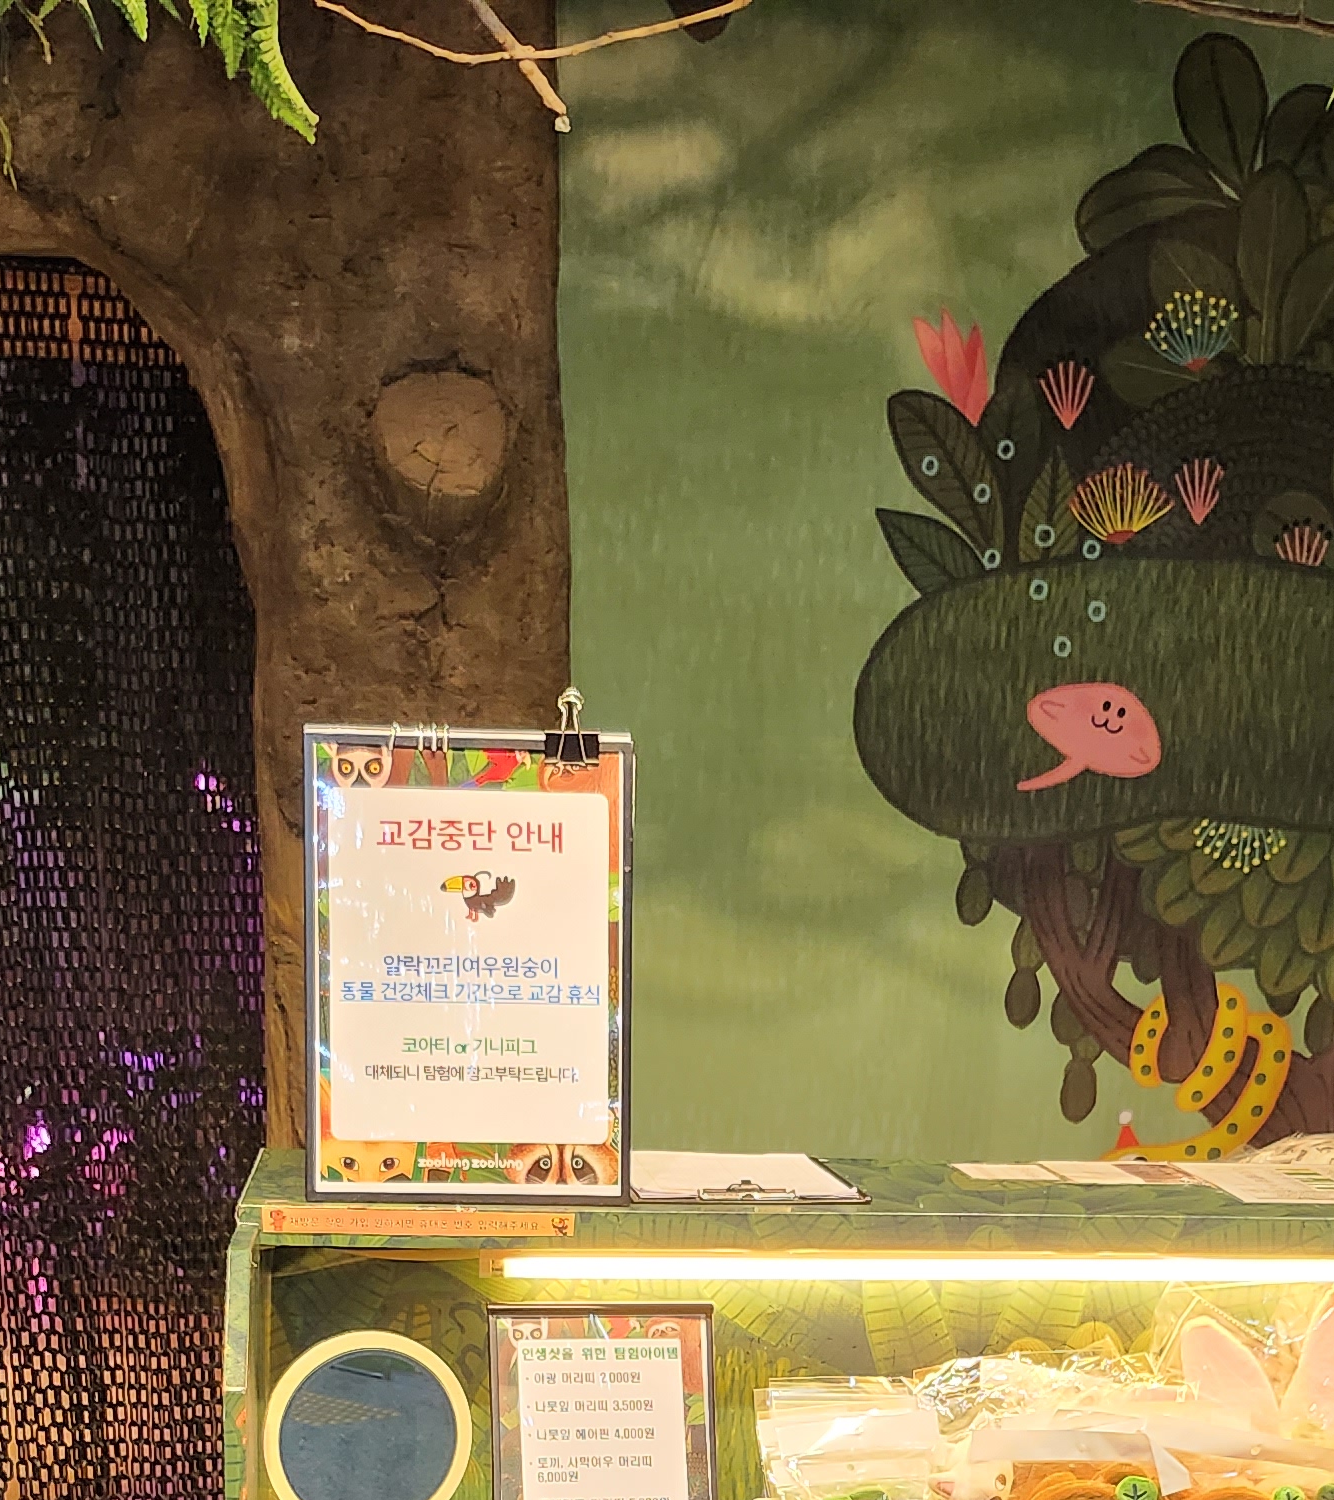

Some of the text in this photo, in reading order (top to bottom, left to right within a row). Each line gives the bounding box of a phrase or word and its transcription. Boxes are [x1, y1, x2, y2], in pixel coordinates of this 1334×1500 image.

[376, 820, 563, 853] 교감중단 안내
[384, 955, 558, 978] 알락꼬리여우원숭이
[341, 981, 600, 1005] 동물 건강체크 기간으로 교감 휴식
[402, 1037, 537, 1056] 코아티 or 기니피그
[366, 1065, 419, 1080] 대체되니
[424, 1065, 464, 1081] 탐험에
[522, 1347, 678, 1361] 인생샷을 위한 탐험아이템
[562, 1372, 595, 1384] 머리띠
[600, 1372, 641, 1383] 2000원
[535, 1401, 569, 1412] 나뭇잎
[575, 1400, 607, 1412] 머리띠
[537, 1429, 570, 1440] 나뭇잎
[576, 1429, 609, 1440] 헤어핀
[568, 1456, 613, 1468] 사막여우
[619, 1456, 652, 1467] 머리띠
